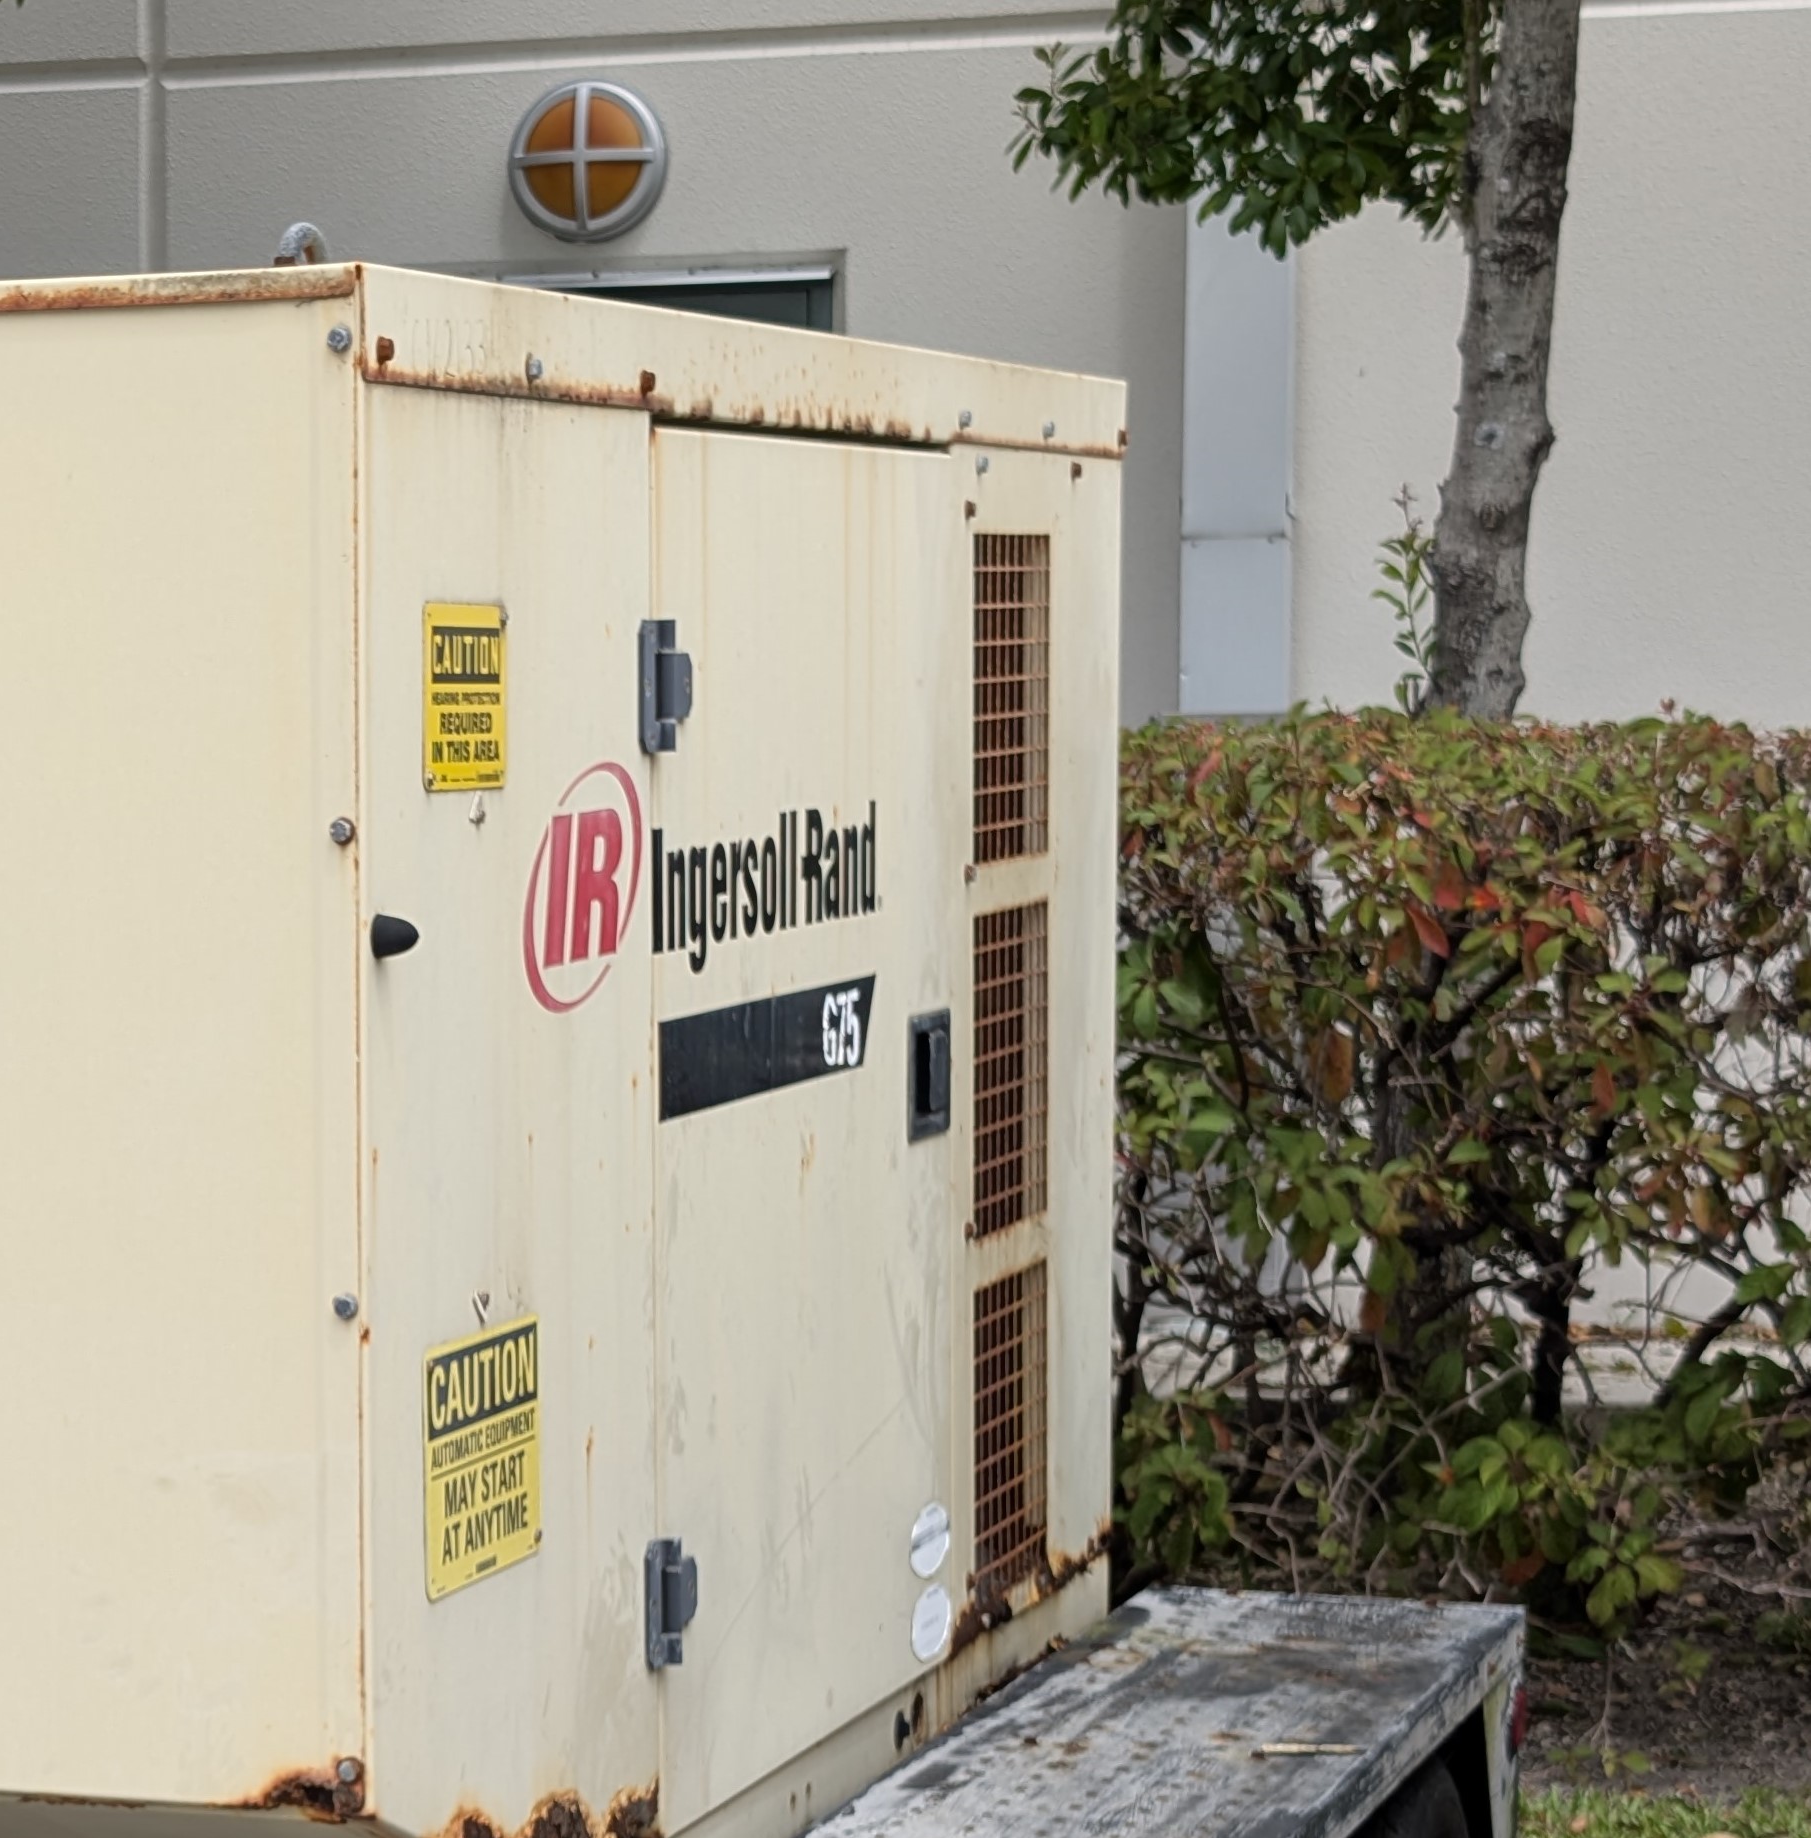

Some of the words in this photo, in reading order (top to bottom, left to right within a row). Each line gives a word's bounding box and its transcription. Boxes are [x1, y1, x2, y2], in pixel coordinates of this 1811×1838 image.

[432, 634, 500, 676] CAUTION
[432, 741, 443, 763] IN
[446, 740, 471, 763] THIS
[473, 739, 501, 762] AREA
[439, 712, 493, 735] REQUIRED
[542, 808, 623, 969] IR
[822, 987, 862, 1067] G75
[430, 1331, 536, 1431] CAUTION
[431, 1428, 484, 1472] AUTOMATIC
[486, 1407, 536, 1449] EQUIPMENT
[444, 1468, 478, 1519] MAY
[480, 1450, 526, 1502] START
[441, 1523, 461, 1567] AT
[464, 1492, 529, 1557] ANYTIME
